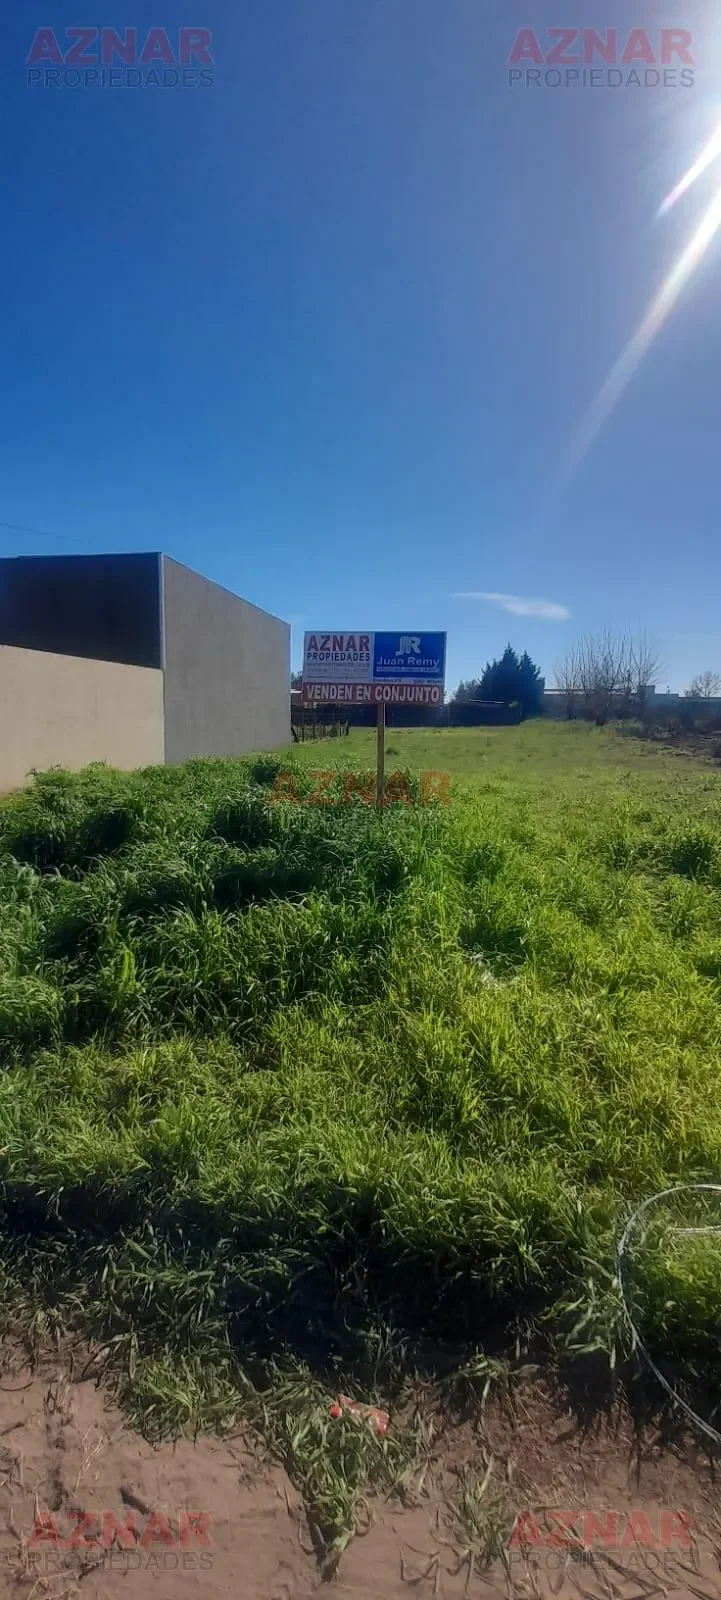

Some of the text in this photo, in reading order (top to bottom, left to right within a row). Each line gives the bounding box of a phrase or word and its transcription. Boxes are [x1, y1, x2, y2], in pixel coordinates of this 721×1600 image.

[307, 635, 370, 651] AZNAR
[307, 652, 370, 661] PROPIEDADES
[377, 656, 404, 666] Juan
[407, 656, 440, 667] Remy
[307, 684, 440, 702] VENDEN EN CONJUNTO
